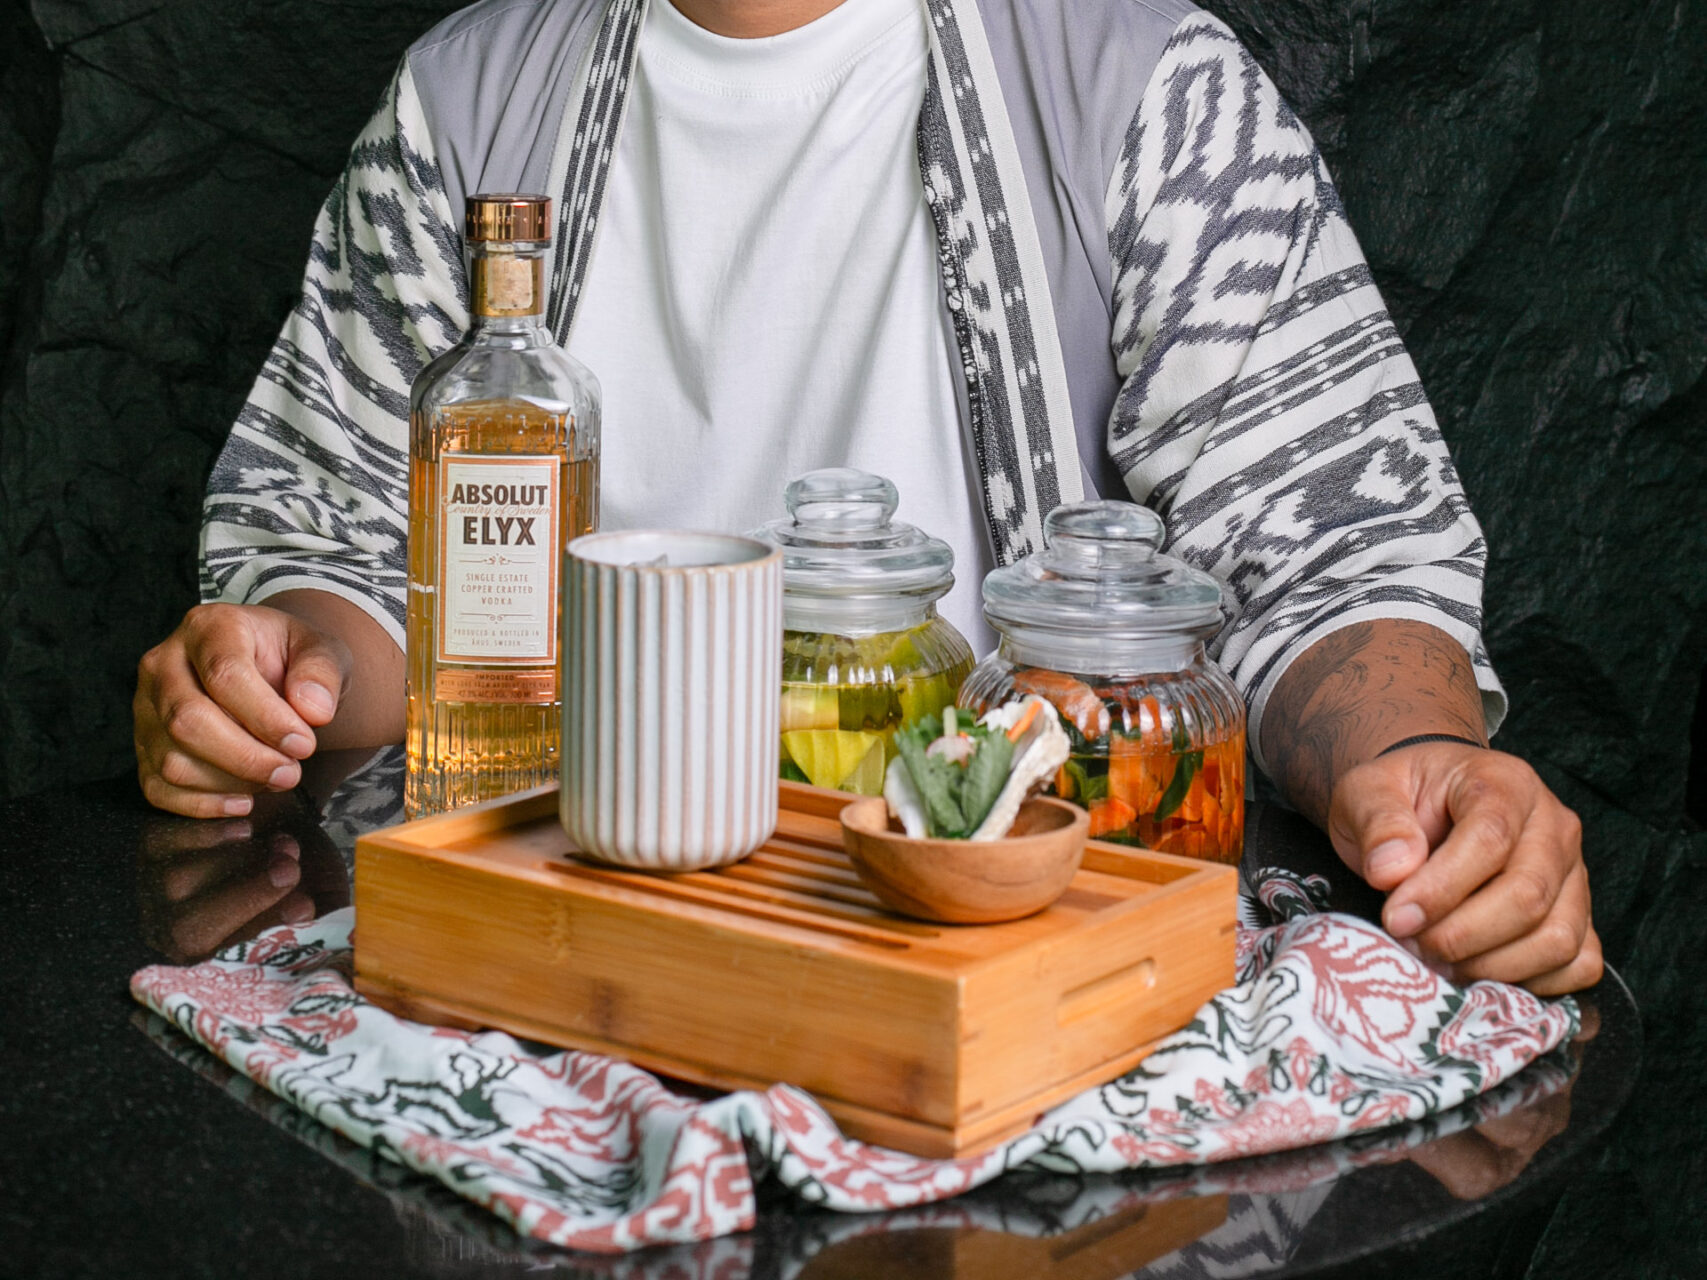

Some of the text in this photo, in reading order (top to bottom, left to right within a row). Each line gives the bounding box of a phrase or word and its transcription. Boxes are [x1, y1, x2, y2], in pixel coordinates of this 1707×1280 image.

[452, 483, 548, 505] ABSOLUT
[463, 516, 536, 546] ELYX
[465, 573, 528, 583] SINGLE ESTATE
[461, 584, 533, 594] COPPER CRAFTED
[481, 597, 513, 605] VODKA
